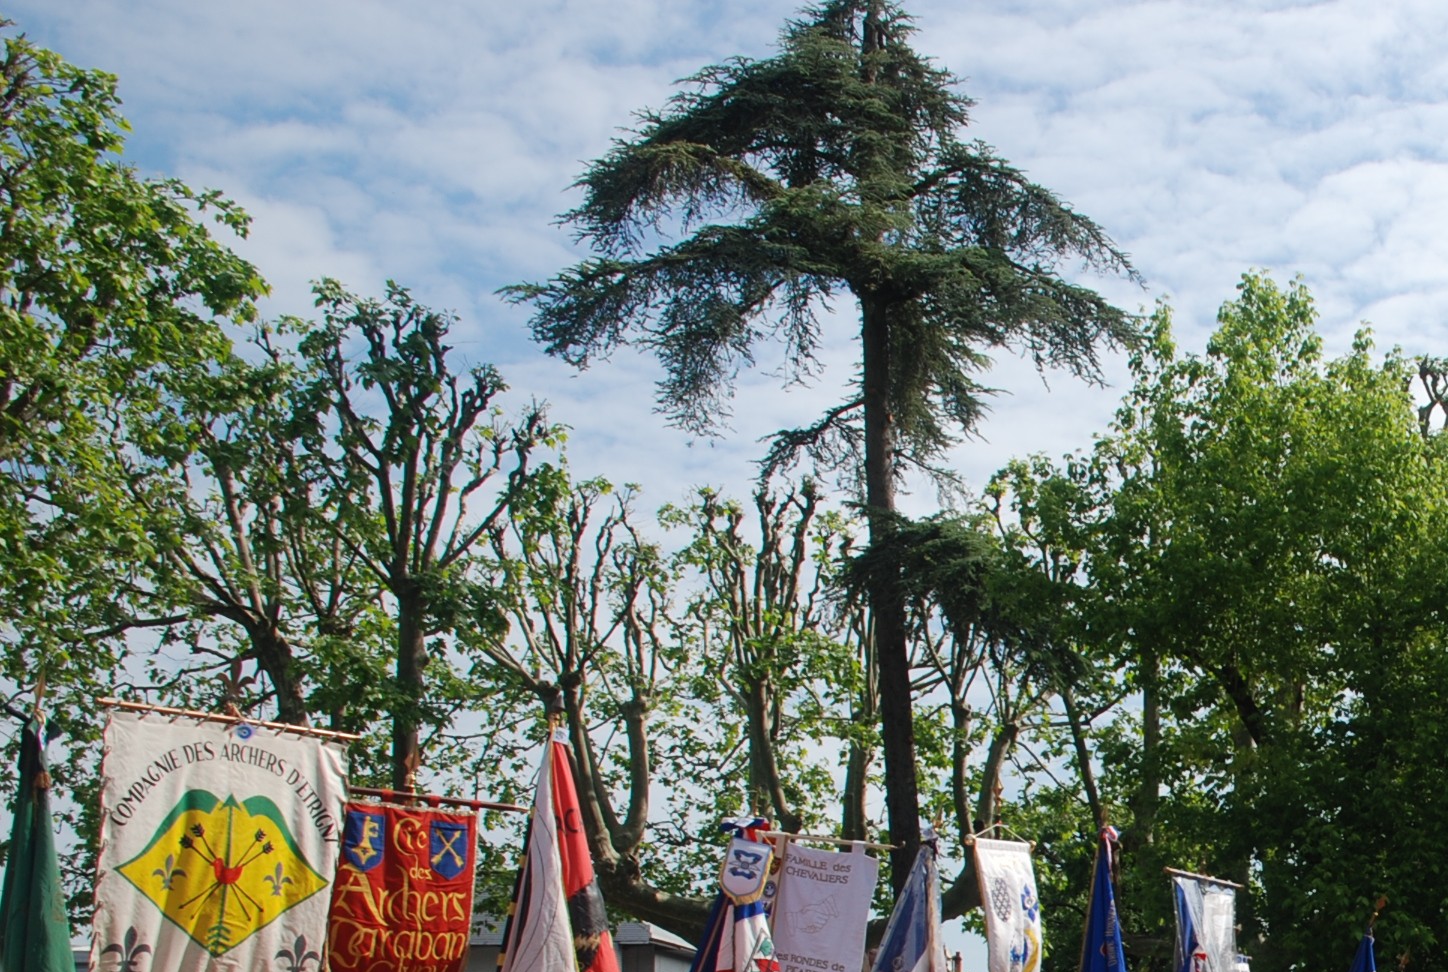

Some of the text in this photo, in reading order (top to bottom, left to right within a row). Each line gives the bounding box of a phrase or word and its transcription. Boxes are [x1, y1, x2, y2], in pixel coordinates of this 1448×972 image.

[109, 749, 183, 827] COMPAGNIE
[183, 741, 215, 765] DES
[219, 744, 287, 777] ARCHERS
[392, 817, 428, 856] Cie
[409, 855, 433, 881] des
[785, 853, 852, 873] FAMILLE des
[785, 866, 849, 884] CHEVALIERS
[334, 863, 467, 927] Archers
[790, 954, 829, 969] RONDES
[831, 961, 846, 972] de
